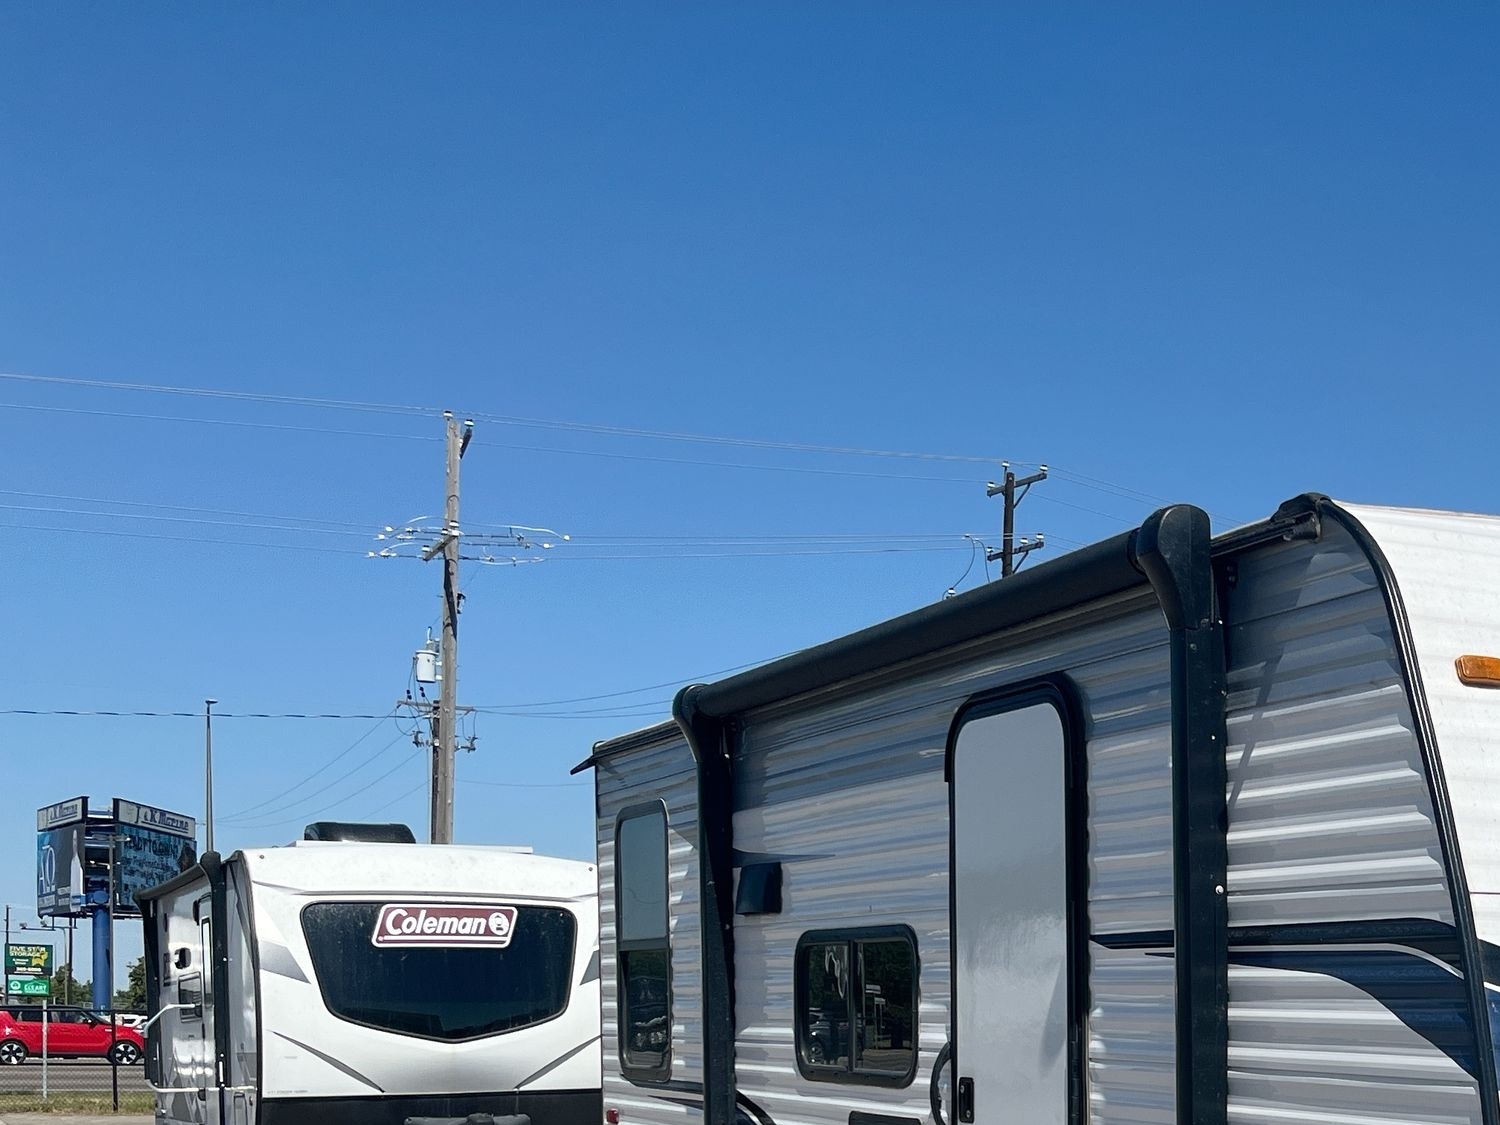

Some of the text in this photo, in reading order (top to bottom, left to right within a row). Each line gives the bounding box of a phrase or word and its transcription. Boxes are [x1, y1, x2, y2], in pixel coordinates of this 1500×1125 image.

[135, 806, 141, 824] J
[149, 809, 160, 823] K
[385, 908, 487, 935] Coleman
